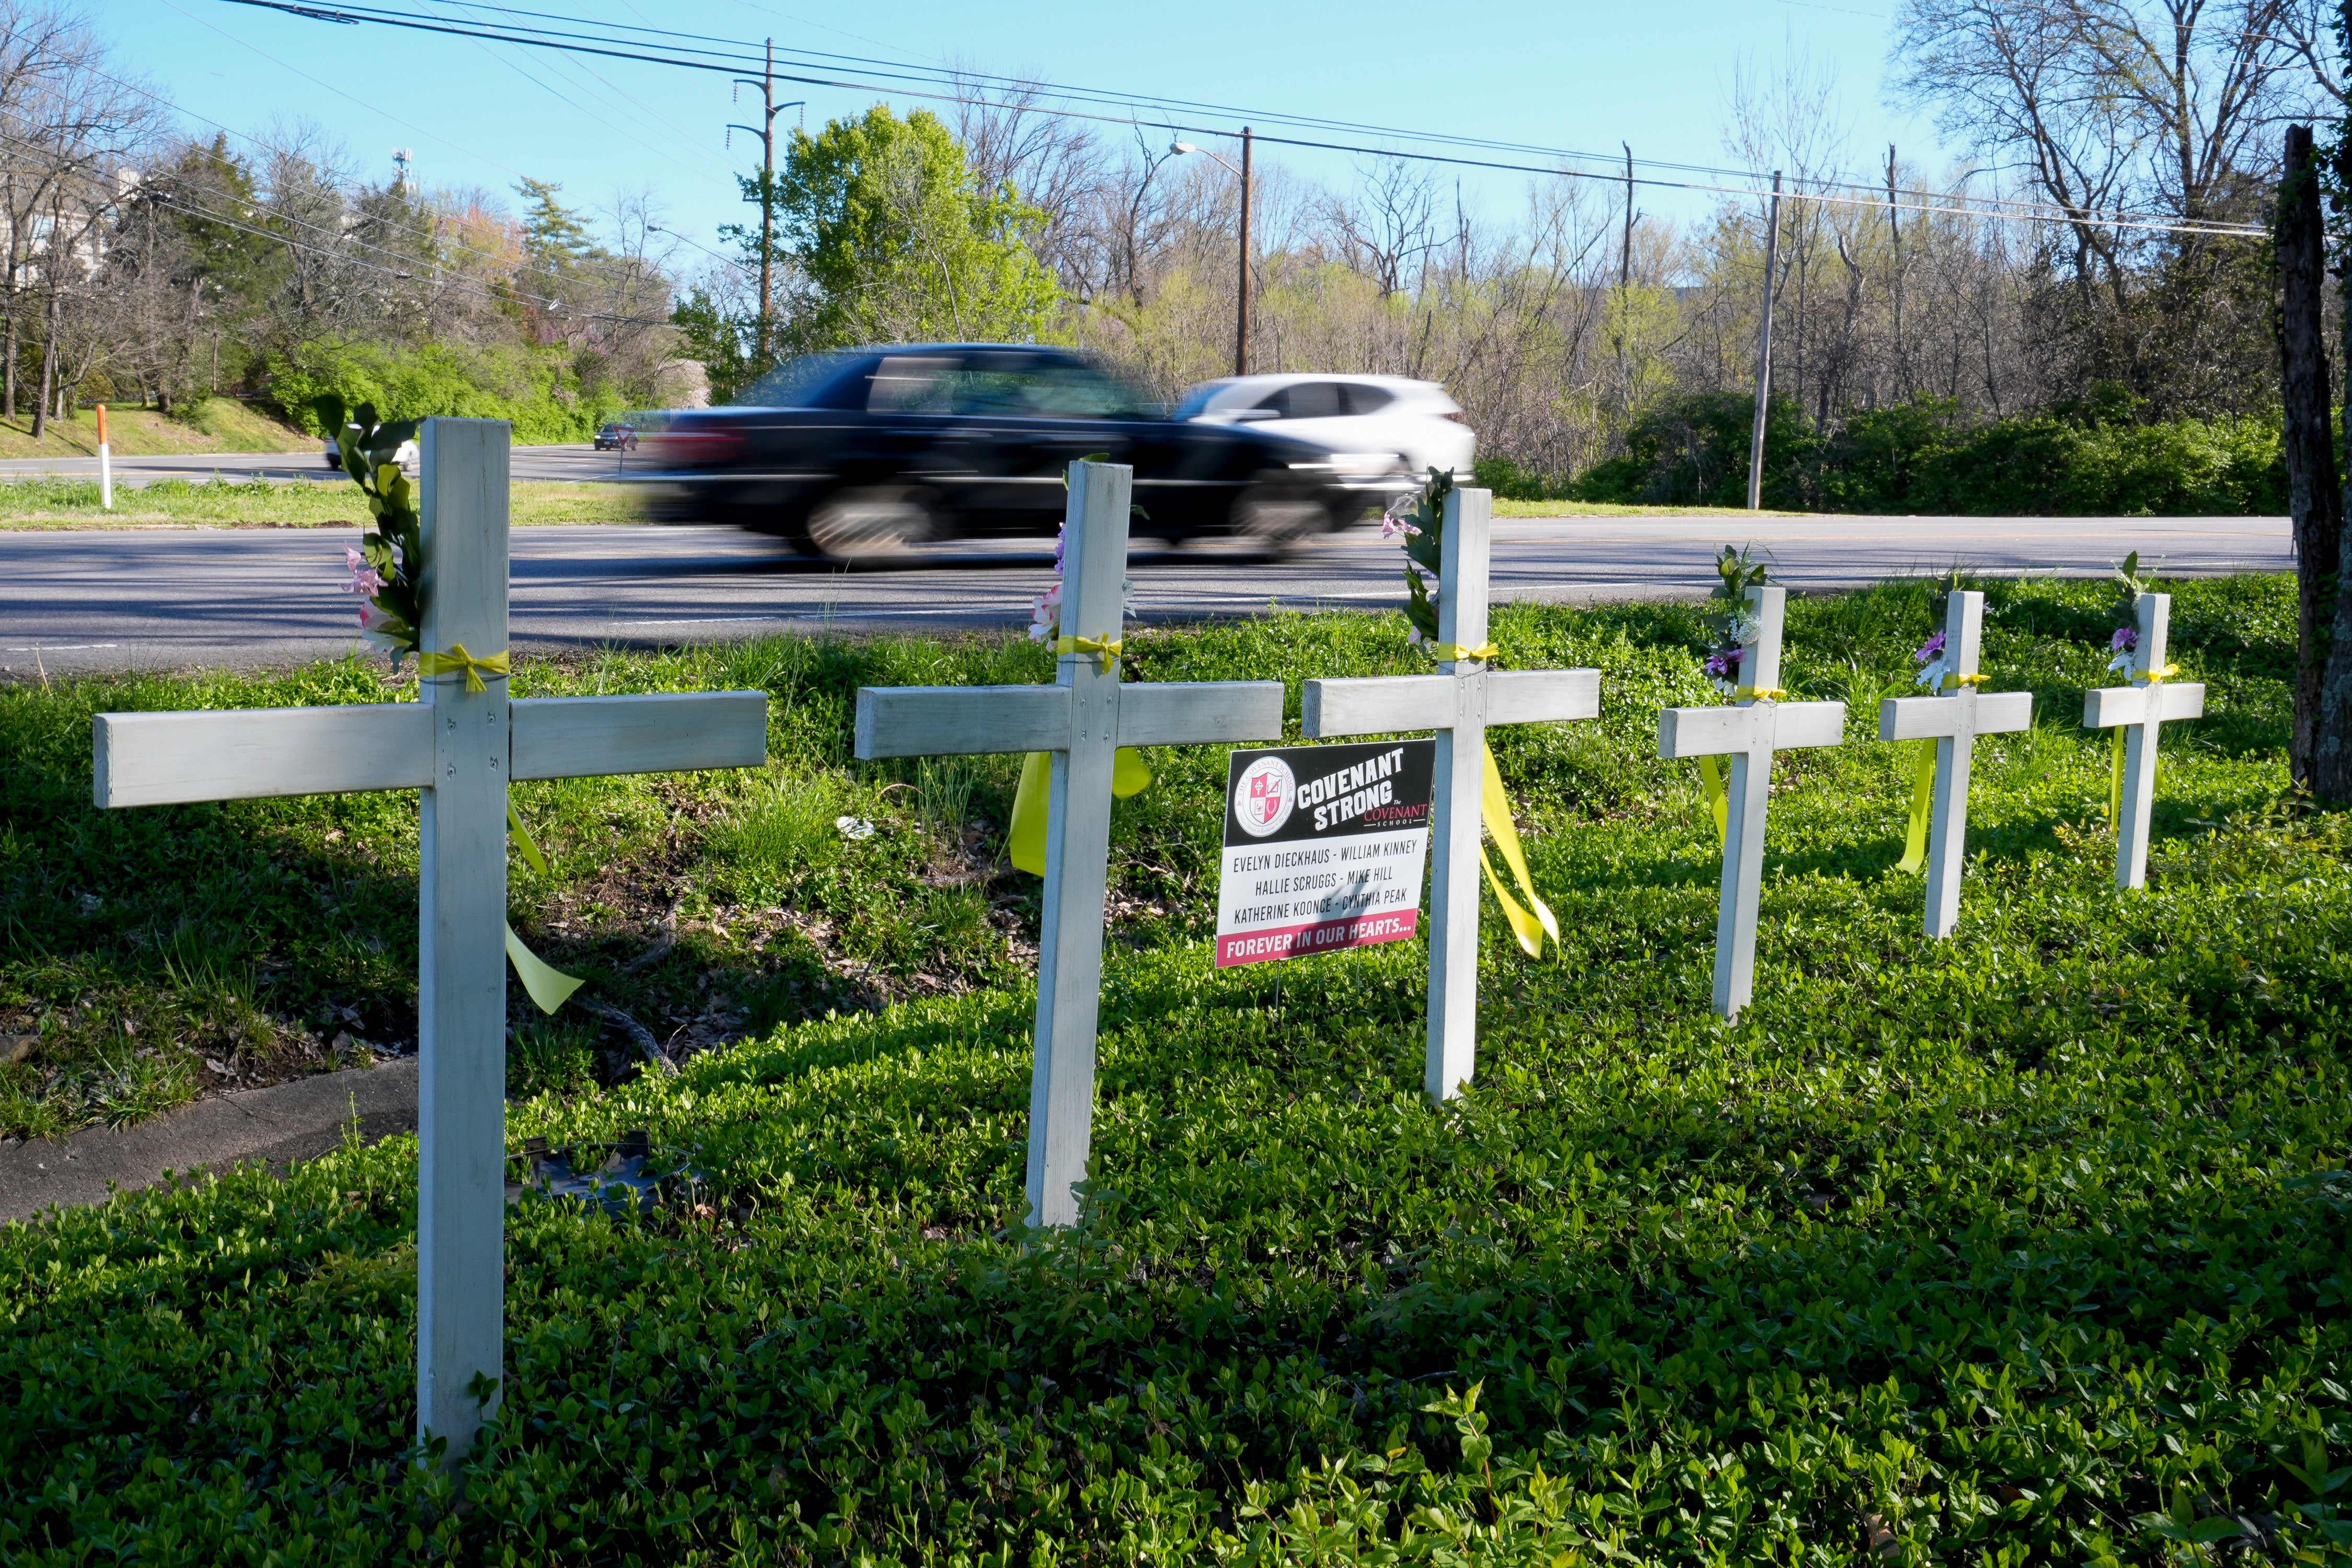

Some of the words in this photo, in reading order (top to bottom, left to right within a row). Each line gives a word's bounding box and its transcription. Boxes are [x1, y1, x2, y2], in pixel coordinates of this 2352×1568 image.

[1246, 759, 1279, 779] COVENANT
[1279, 764, 1294, 793] SCHOOL
[1297, 747, 1403, 810] COVENANT
[1314, 780, 1392, 831] STRONG
[1364, 804, 1428, 822] COVENANT
[1377, 818, 1412, 827] SCHOOL
[1233, 855, 1271, 872] EVELYN
[1275, 849, 1330, 868] DIECKHAUS
[1341, 844, 1380, 861] WILLIAM
[1383, 839, 1417, 856] KINNEY
[1255, 878, 1290, 896] HALLIE
[1293, 873, 1336, 892] SCRUGGS
[1347, 869, 1370, 885] MIKE
[1374, 866, 1392, 882] HILL
[1235, 903, 1290, 924] KATHERINE
[1293, 898, 1332, 917] KOONCE
[1342, 891, 1380, 910] CYNTHIA
[1384, 888, 1408, 904] PEAK
[1227, 933, 1293, 959] FOREVER
[1296, 931, 1311, 948] IN
[1316, 926, 1345, 945] OUR
[1349, 917, 1411, 940] HEARTS...
